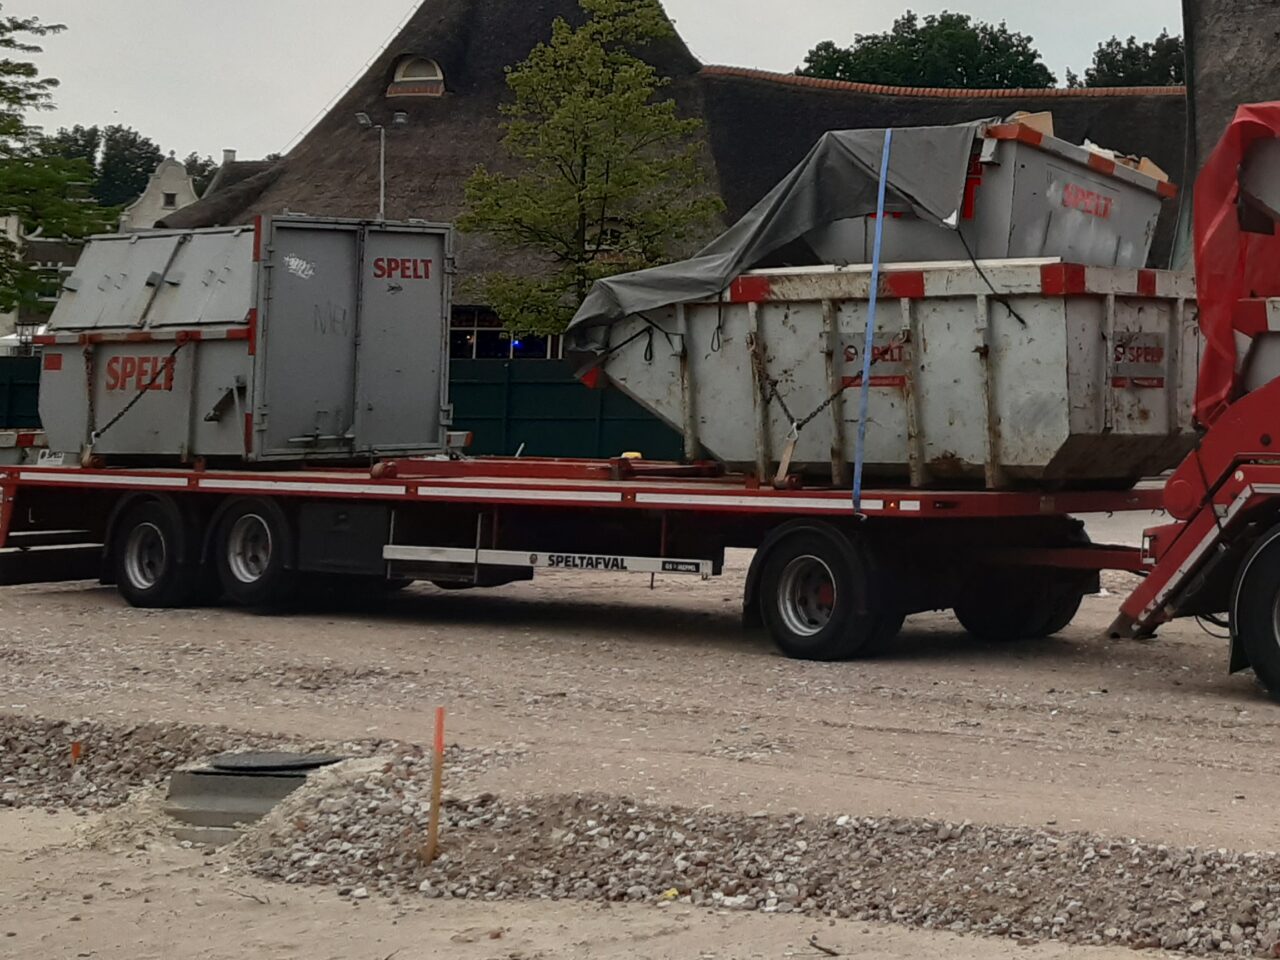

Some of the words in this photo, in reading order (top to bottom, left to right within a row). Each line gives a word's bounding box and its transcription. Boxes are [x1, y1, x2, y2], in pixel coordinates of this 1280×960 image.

[373, 258, 433, 280] SPELT
[863, 344, 904, 362] PELT
[105, 356, 177, 392] SPELT
[547, 554, 628, 570] SPELTAFVAL
